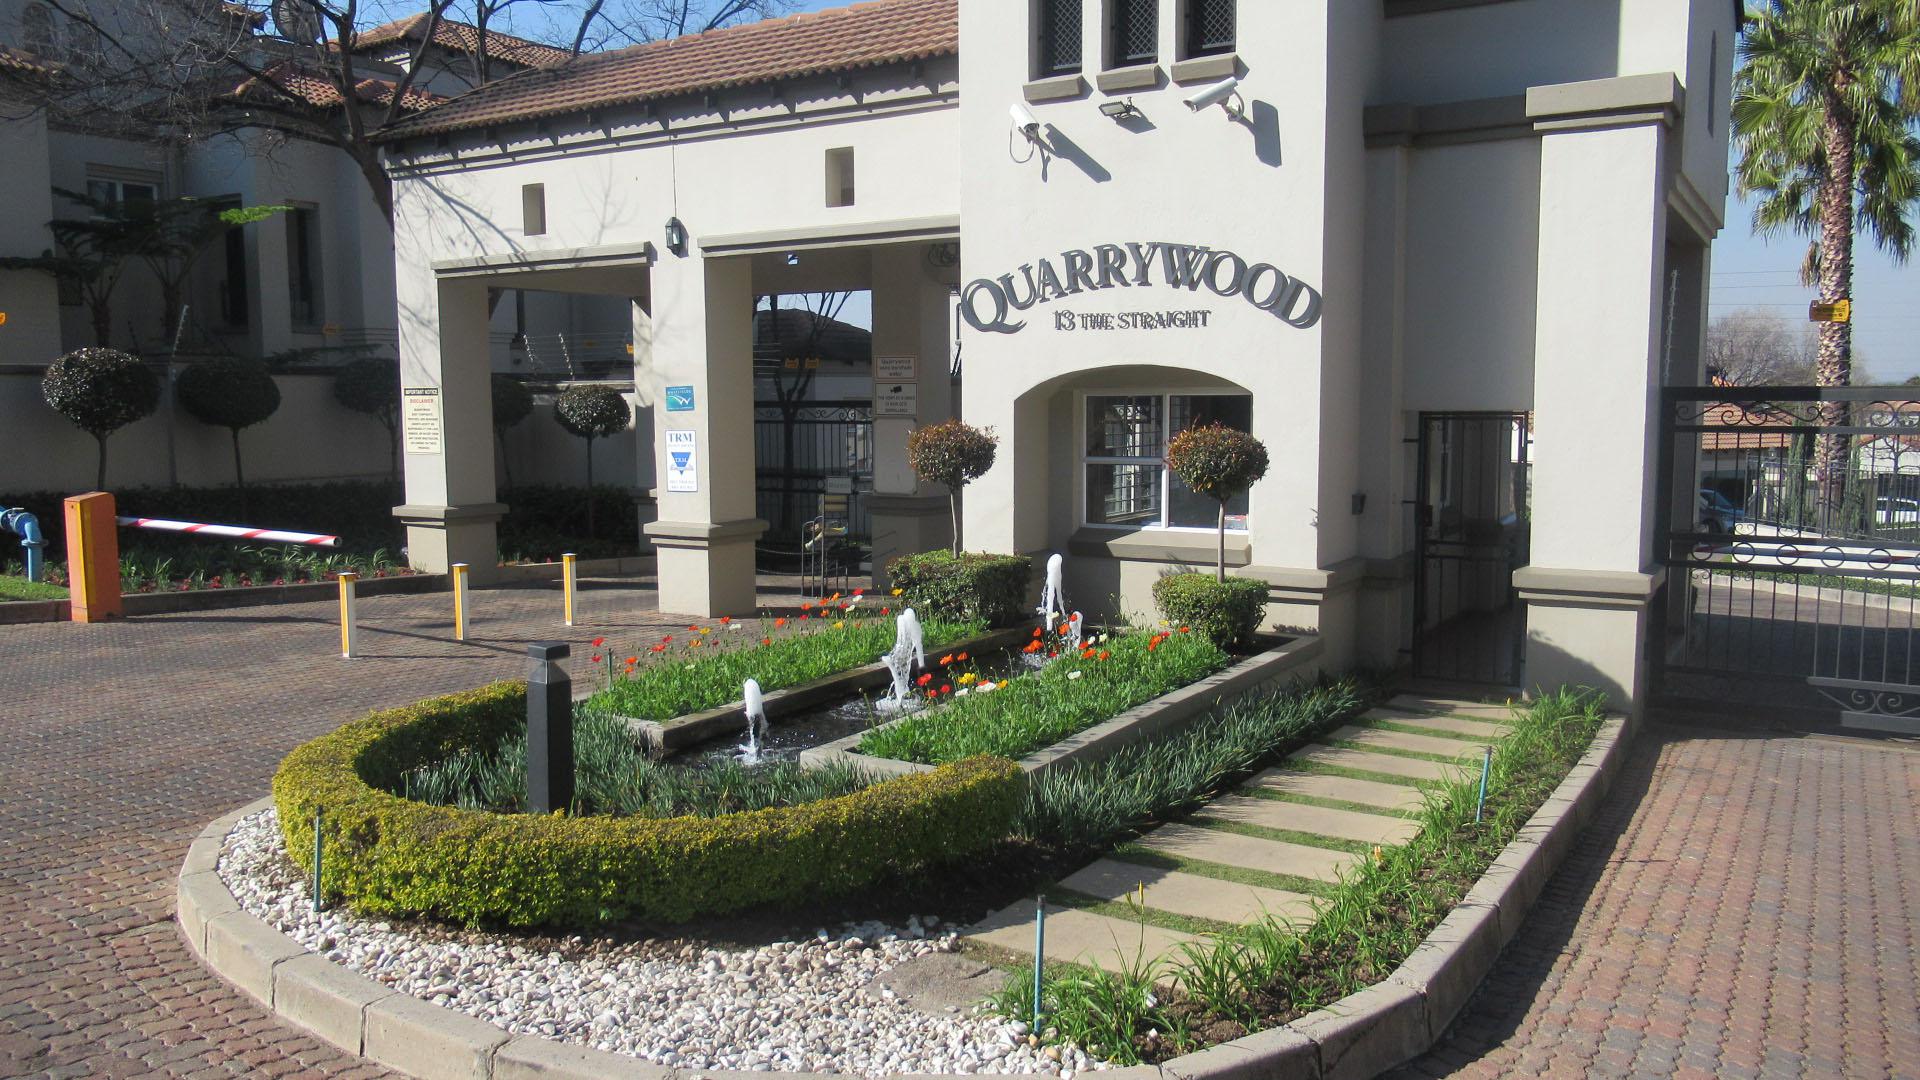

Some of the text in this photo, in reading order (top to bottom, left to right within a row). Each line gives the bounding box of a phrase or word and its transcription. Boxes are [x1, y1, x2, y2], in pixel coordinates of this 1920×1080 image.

[961, 242, 1323, 334] QUARRYWOOD
[1053, 310, 1211, 331] 13 THE STRAIGHT
[669, 432, 693, 443] TRM
